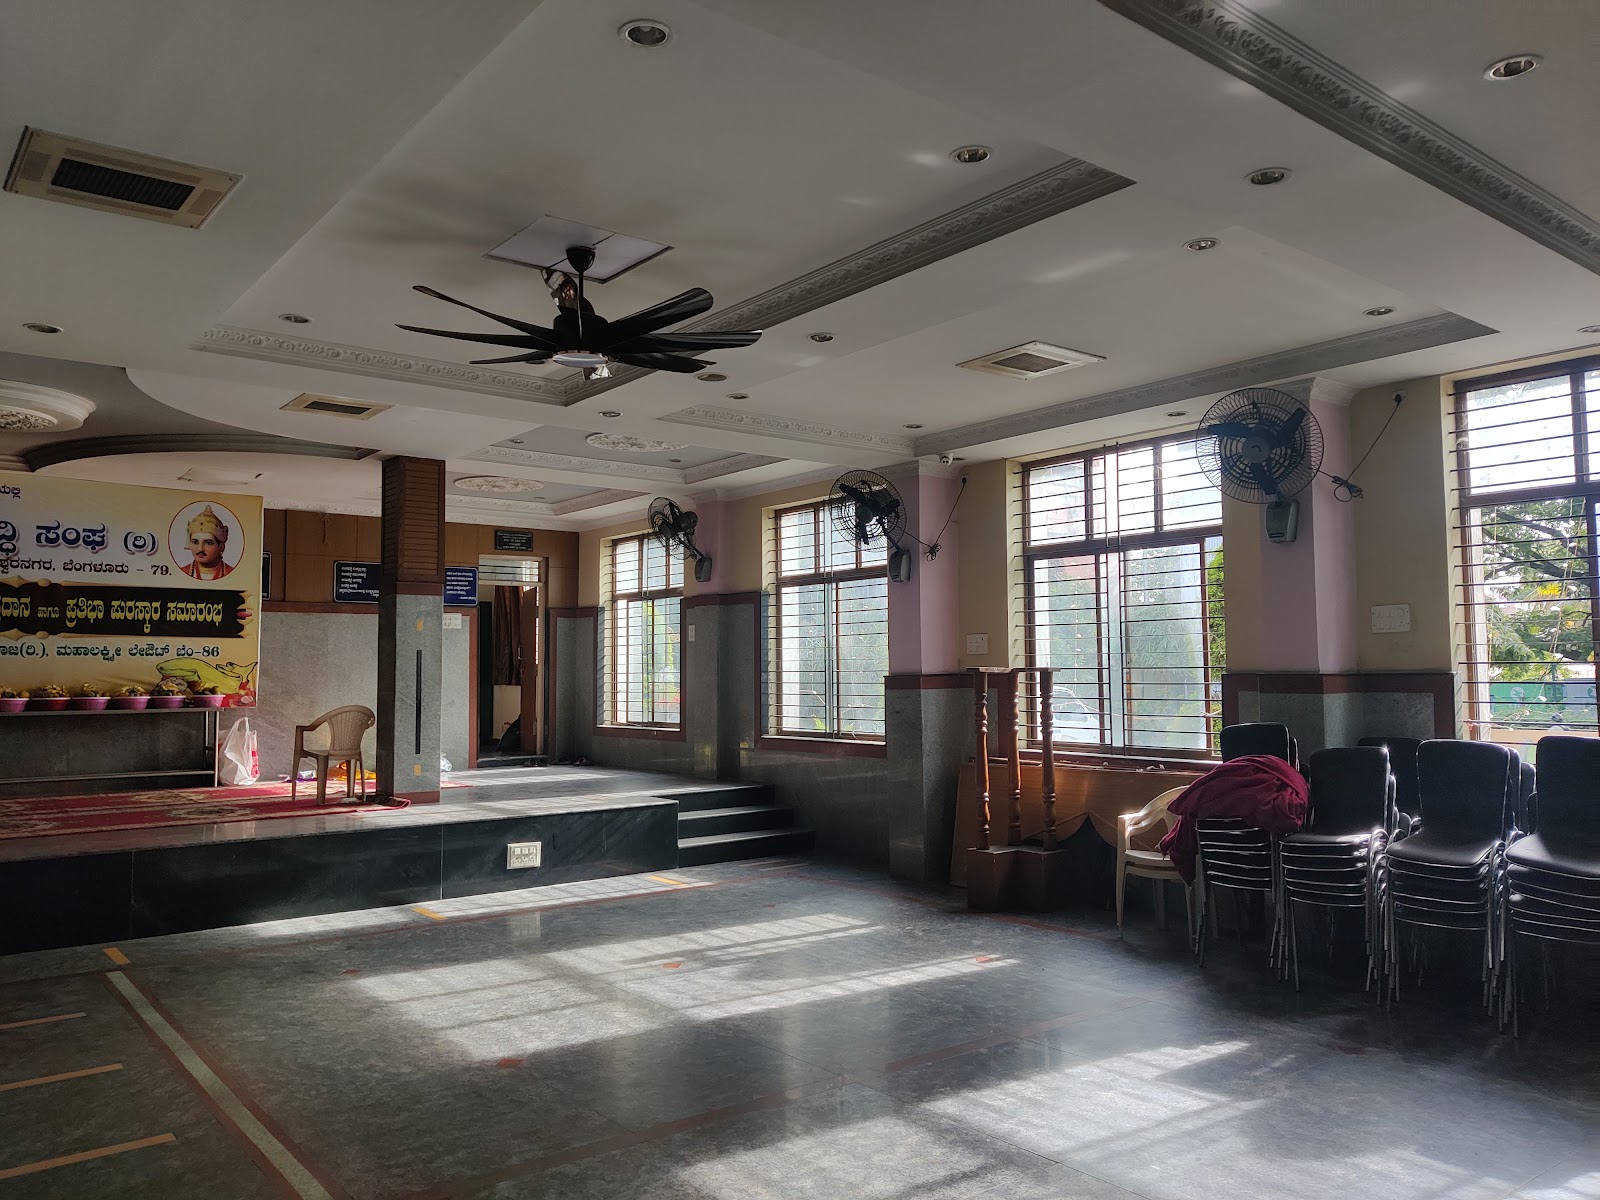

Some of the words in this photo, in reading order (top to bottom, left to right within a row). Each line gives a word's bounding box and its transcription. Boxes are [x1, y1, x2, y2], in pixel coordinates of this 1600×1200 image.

[36, 519, 106, 551] ಸಂಘ
[123, 531, 156, 553] (ರಿ)
[63, 559, 129, 574] ಬೆಂಗಳೂರು
[150, 564, 172, 576] 79.
[0, 596, 31, 618] ದಾನ
[37, 606, 60, 618] ಹಾಗೂ
[65, 597, 105, 628] ಪ್ರತಿಭಾ
[110, 599, 161, 634] ಪುರಸ್ಕಾರ
[166, 601, 223, 627] ಸಮಾರಂಭ
[56, 643, 122, 662] ಮಹಾಲಕ್ಷ್ಮೀ
